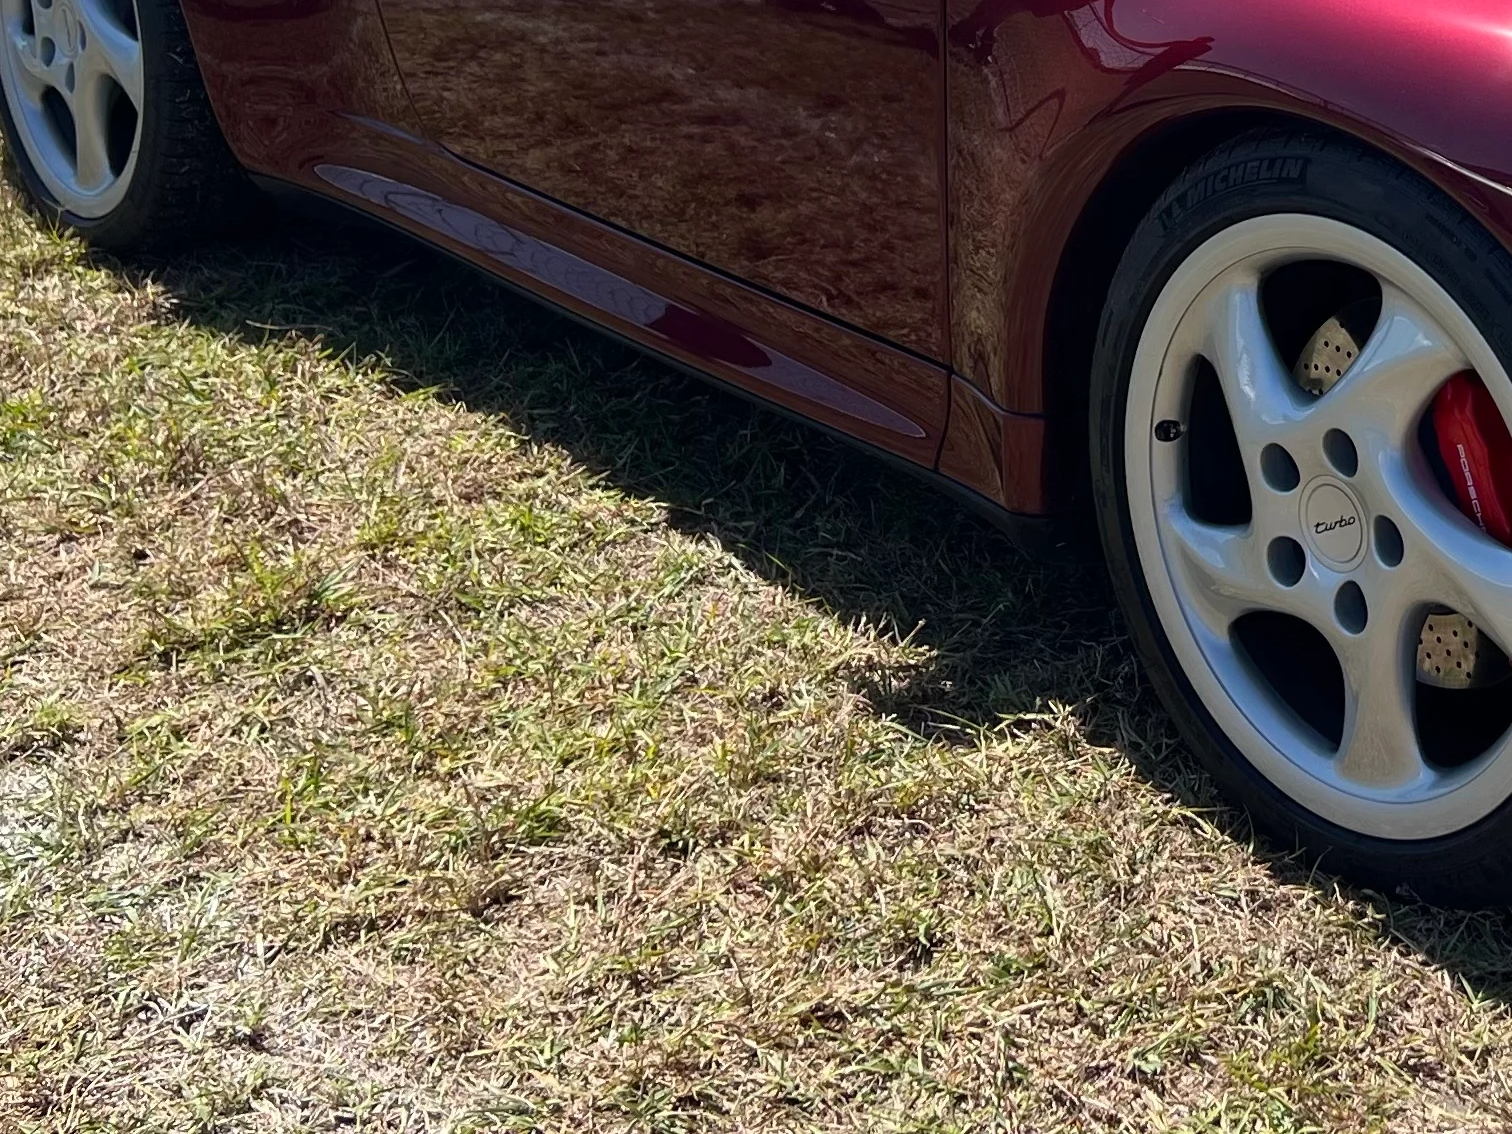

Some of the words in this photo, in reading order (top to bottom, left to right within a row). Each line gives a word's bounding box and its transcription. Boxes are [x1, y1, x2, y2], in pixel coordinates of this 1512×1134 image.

[1187, 157, 1305, 208] MICHELIN
[1456, 443, 1487, 533] PORSCH
[1313, 514, 1356, 534] turbo
